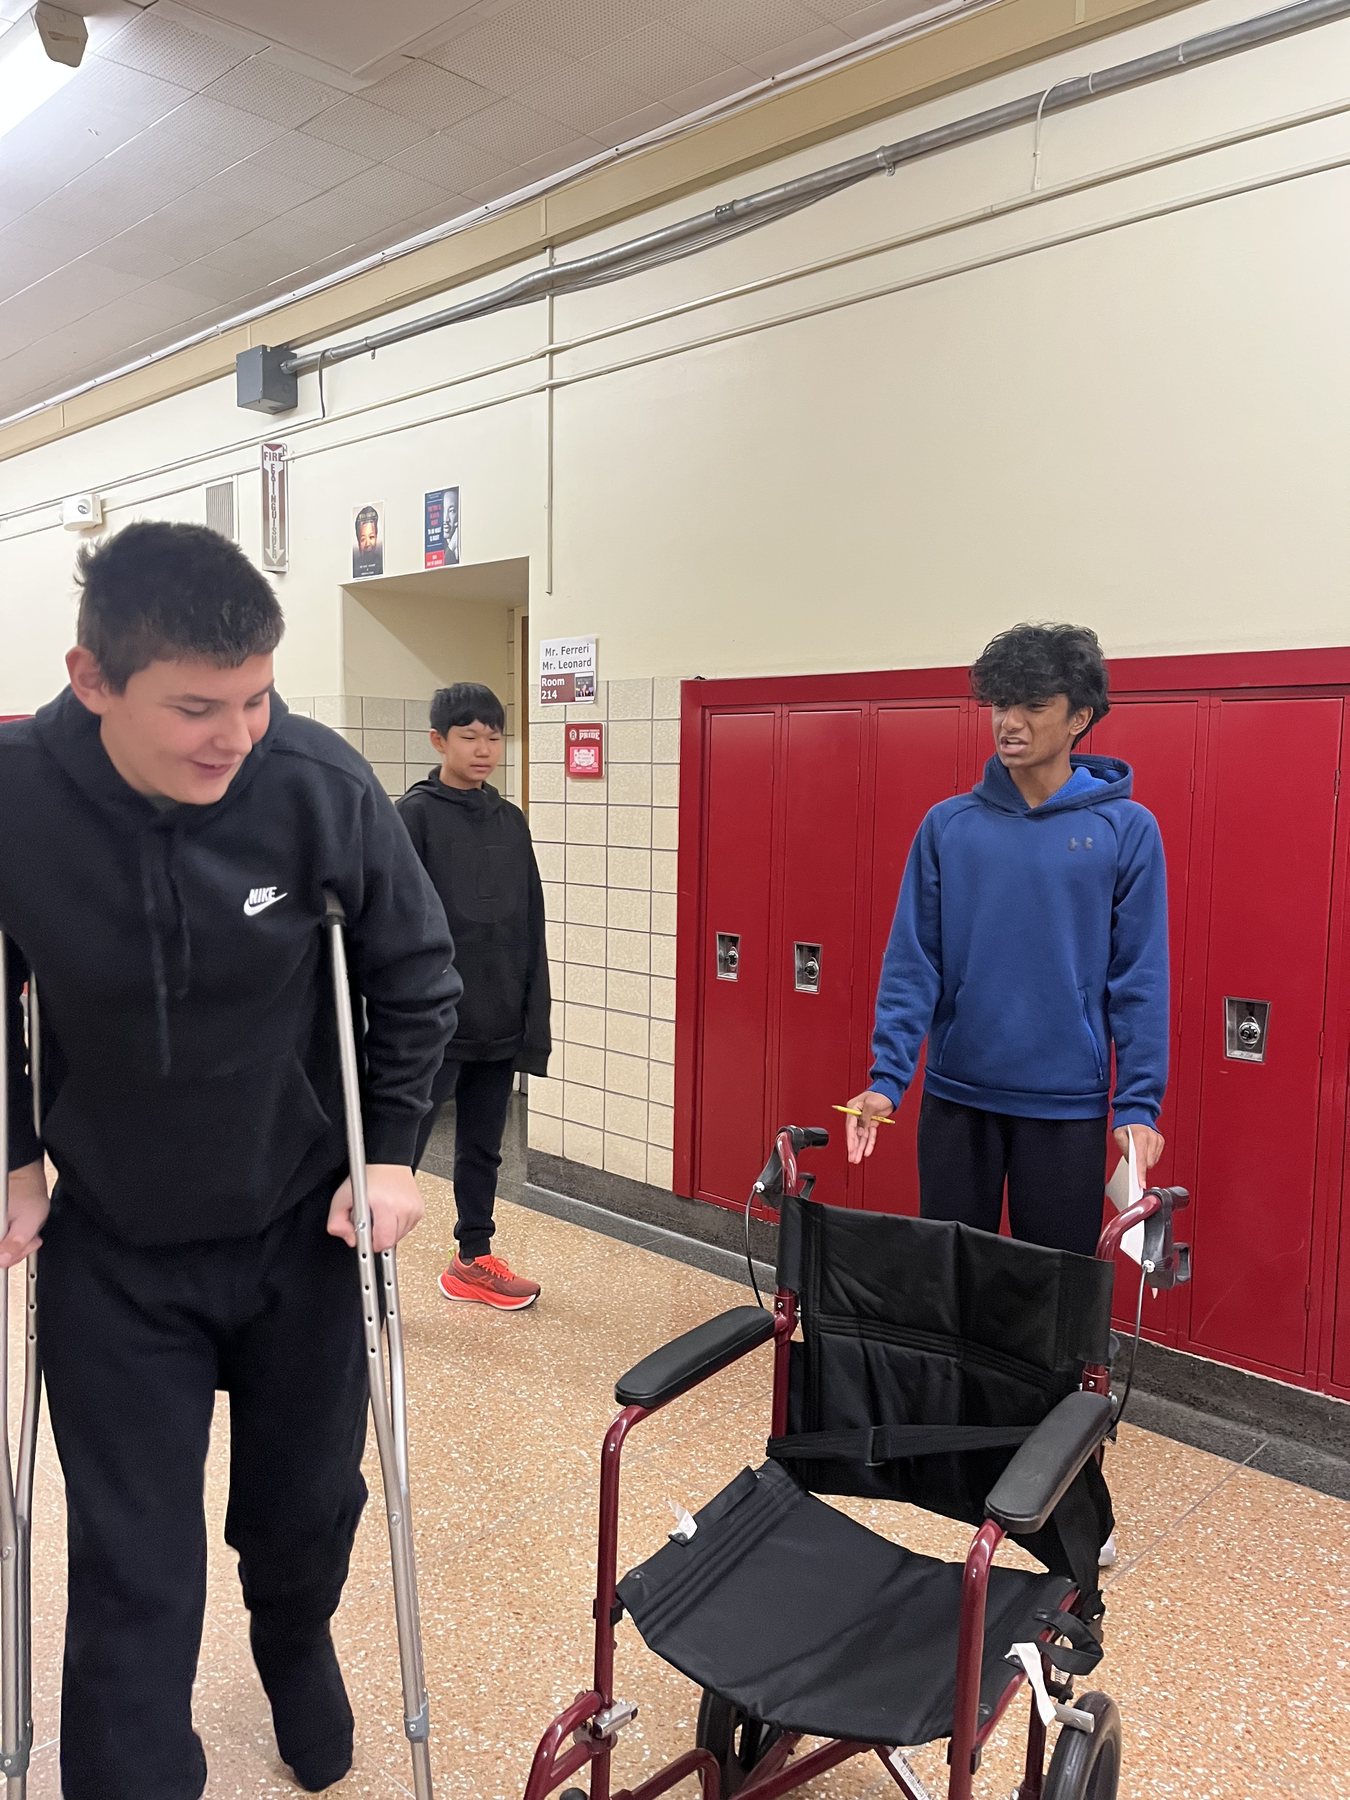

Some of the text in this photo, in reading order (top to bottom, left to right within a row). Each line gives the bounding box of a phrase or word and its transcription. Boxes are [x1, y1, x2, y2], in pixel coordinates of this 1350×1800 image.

[264, 452, 283, 461] FIRE
[545, 643, 590, 657] Mr. Ferreri
[542, 657, 592, 670] Mr. Leonard
[541, 677, 565, 687] Room
[541, 690, 558, 699] 214
[579, 731, 600, 740] PRIDE
[249, 886, 277, 904] NIKE
